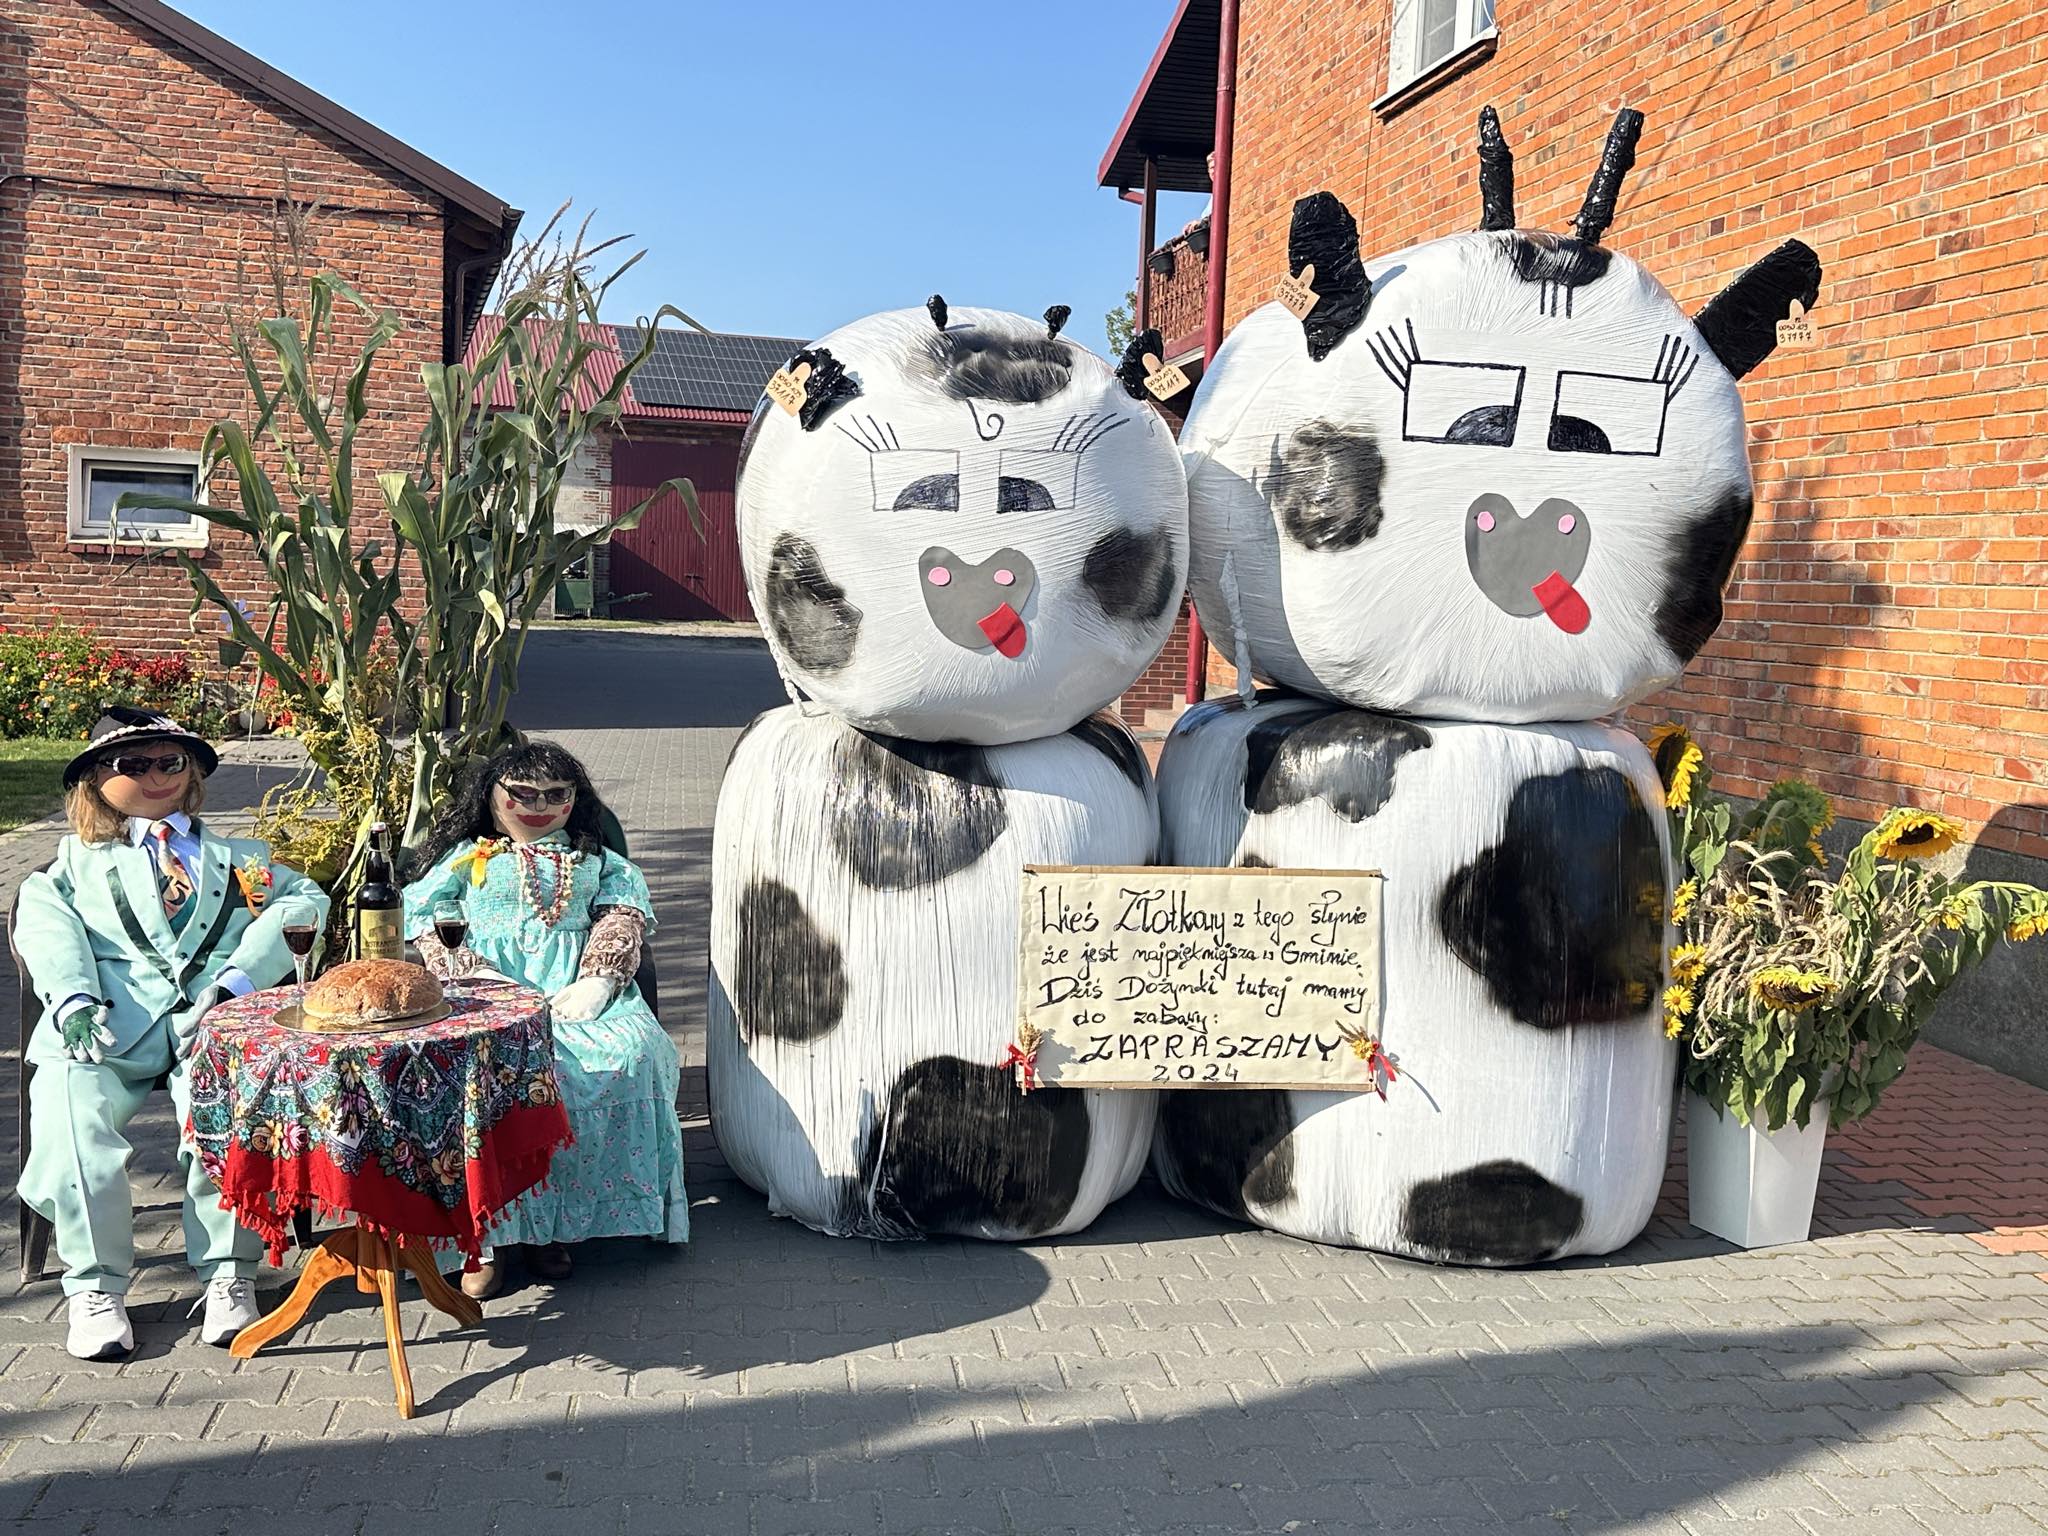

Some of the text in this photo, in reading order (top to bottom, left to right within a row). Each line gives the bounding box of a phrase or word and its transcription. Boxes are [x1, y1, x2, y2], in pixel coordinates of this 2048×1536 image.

[1039, 885, 1099, 934] Wieś
[1233, 912, 1245, 928] z
[1253, 898, 1294, 946] tego
[1041, 945, 1069, 965] że
[1077, 940, 1119, 980] jest
[1035, 976, 1103, 1008] Dziś
[1114, 969, 1219, 1011] Dożynki
[1236, 973, 1293, 1018] tutaj
[1072, 1009, 1106, 1027] do
[1077, 1032, 1343, 1064] ZAPRASZAMY
[1151, 1063, 1239, 1084] 2024
